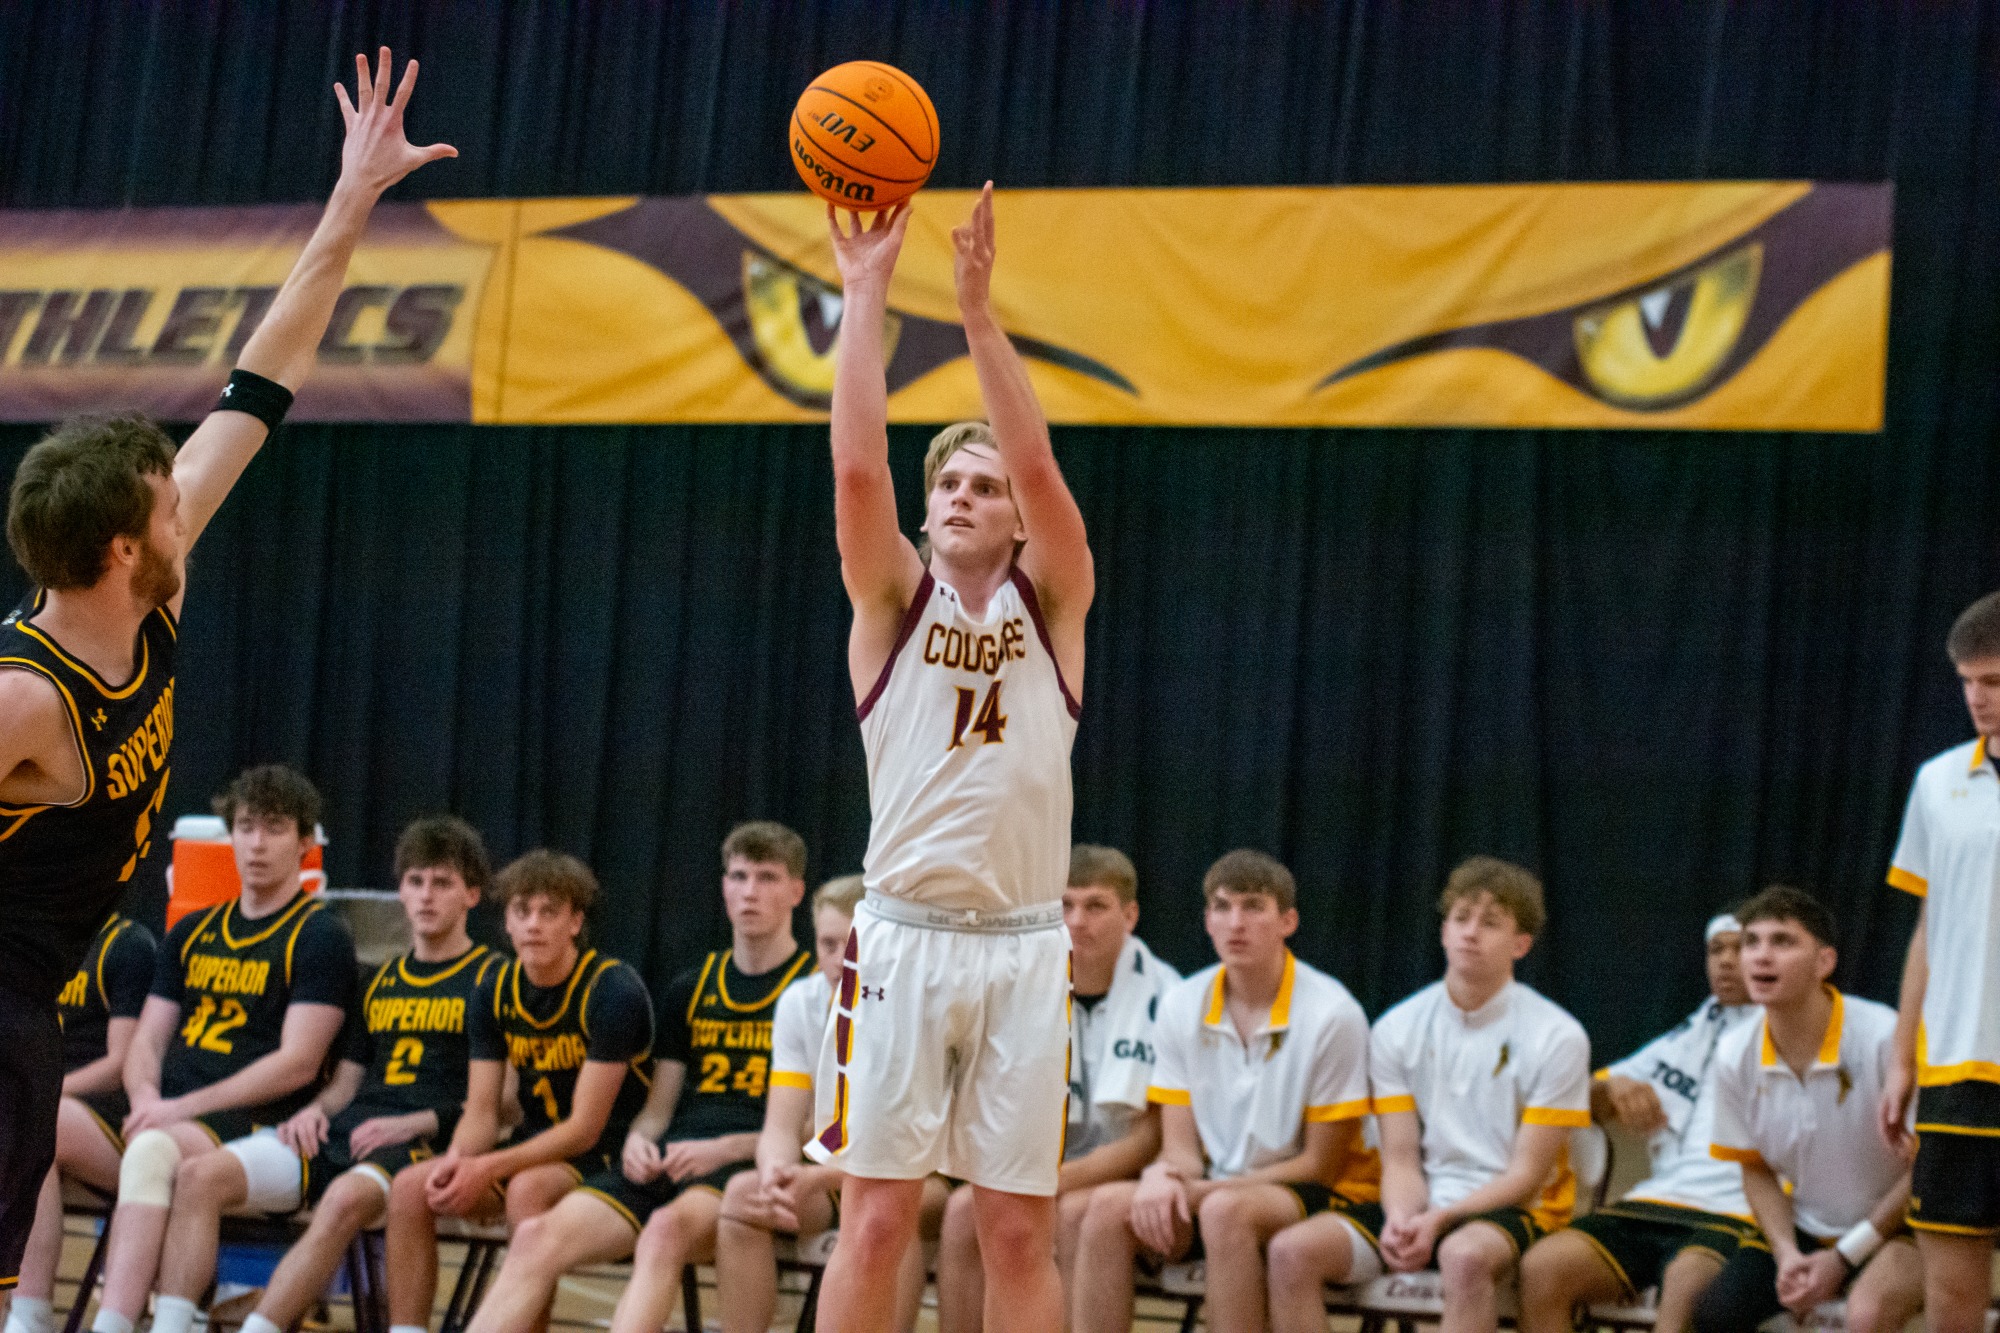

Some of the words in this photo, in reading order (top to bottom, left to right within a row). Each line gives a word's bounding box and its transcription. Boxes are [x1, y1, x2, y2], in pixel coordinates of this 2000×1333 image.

[819, 111, 877, 154] EVO
[794, 136, 876, 202] Wilson
[107, 676, 175, 800] SUPERIO
[946, 680, 1009, 752] 14
[185, 953, 270, 996] SUPERIOR
[182, 995, 248, 1056] 42
[368, 996, 466, 1034] SUPERIOR
[384, 1037, 425, 1086] 2
[698, 1053, 768, 1097] 24
[532, 1076, 559, 1124] 1
